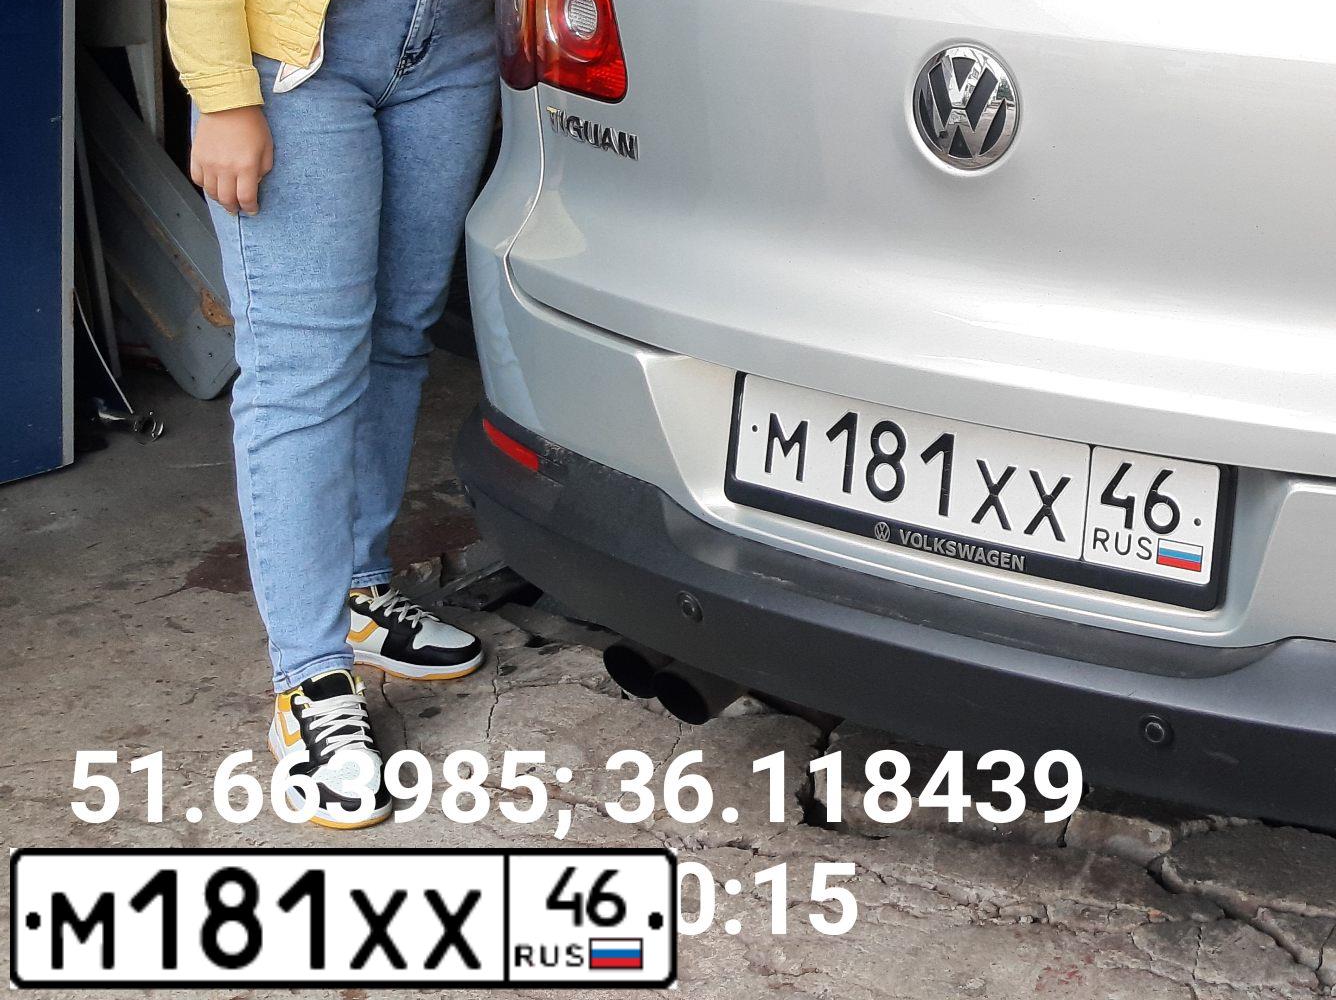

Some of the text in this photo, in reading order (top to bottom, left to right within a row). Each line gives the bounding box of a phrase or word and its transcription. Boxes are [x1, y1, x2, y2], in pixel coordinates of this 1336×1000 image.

[546, 105, 639, 161] TIGUAN
[1100, 461, 1183, 536] 46
[898, 527, 1027, 572] VOLKSWAGEN
[1092, 527, 1154, 561] RUS
